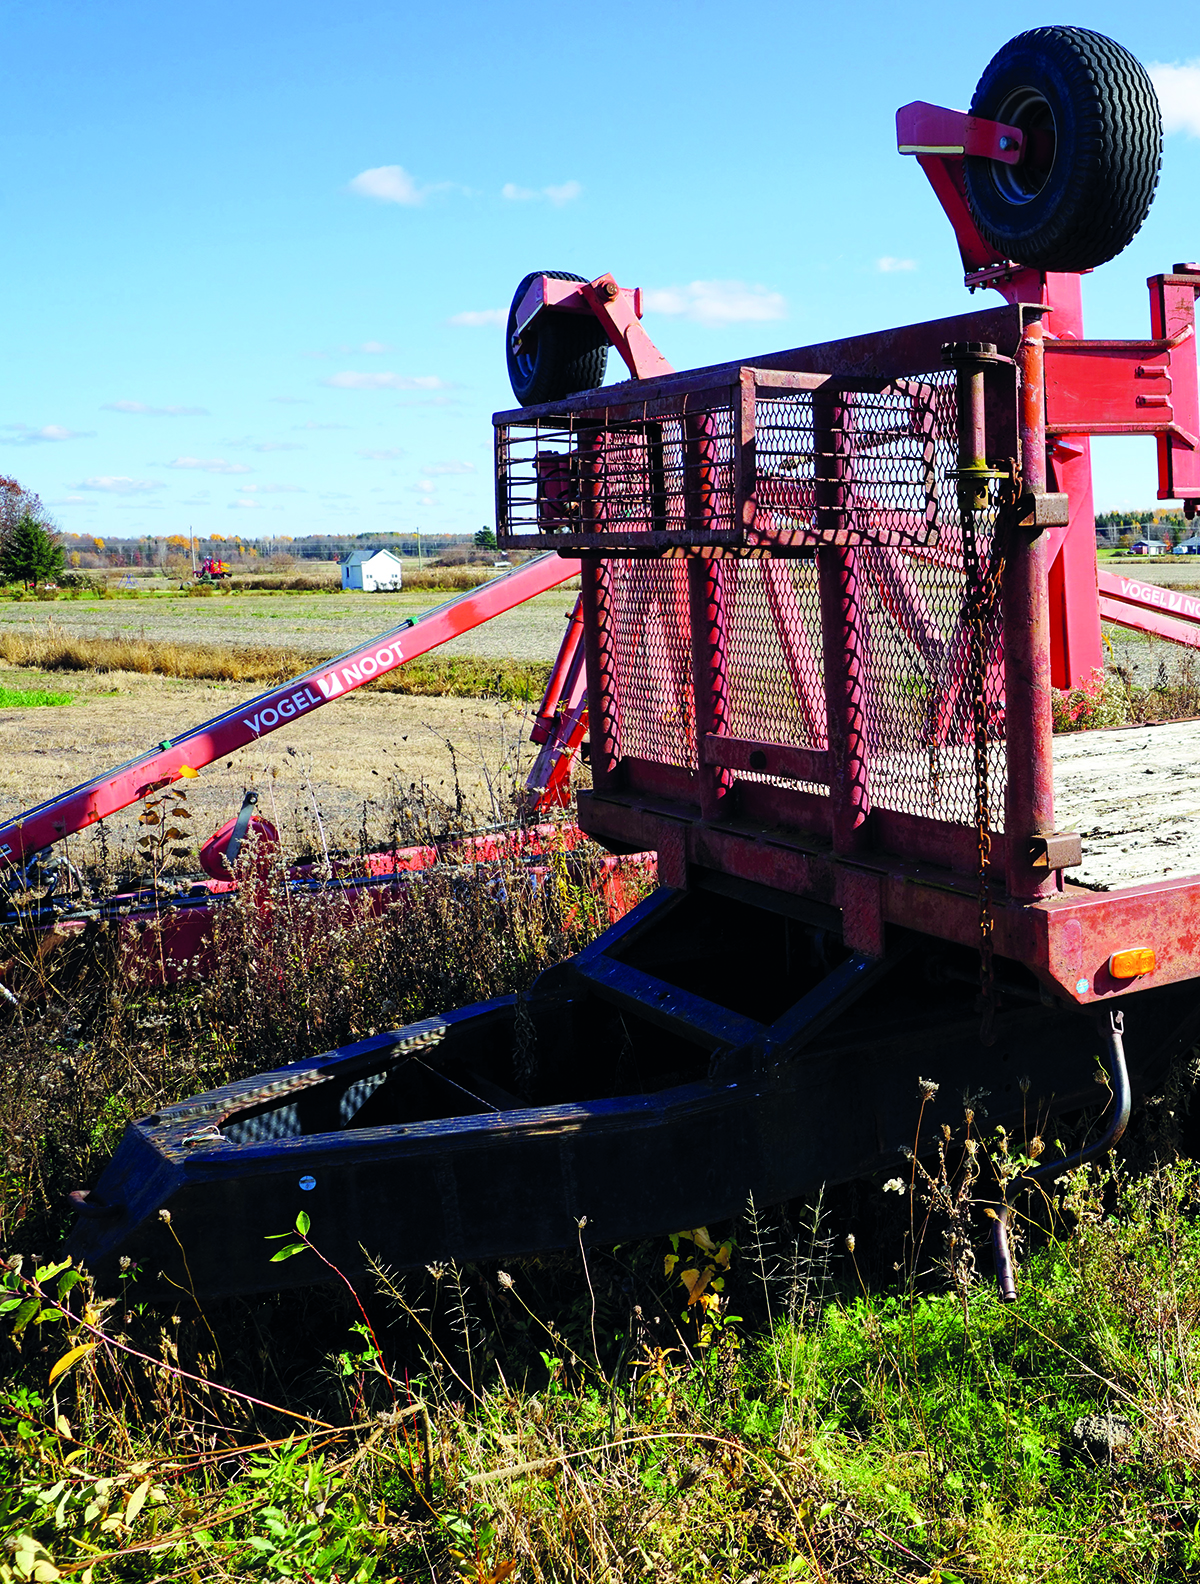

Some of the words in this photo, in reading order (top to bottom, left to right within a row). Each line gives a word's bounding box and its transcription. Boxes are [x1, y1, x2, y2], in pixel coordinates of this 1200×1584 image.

[1121, 580, 1167, 607] VOGEL
[242, 687, 322, 733] VOGEL
[341, 640, 404, 685] NOOT
